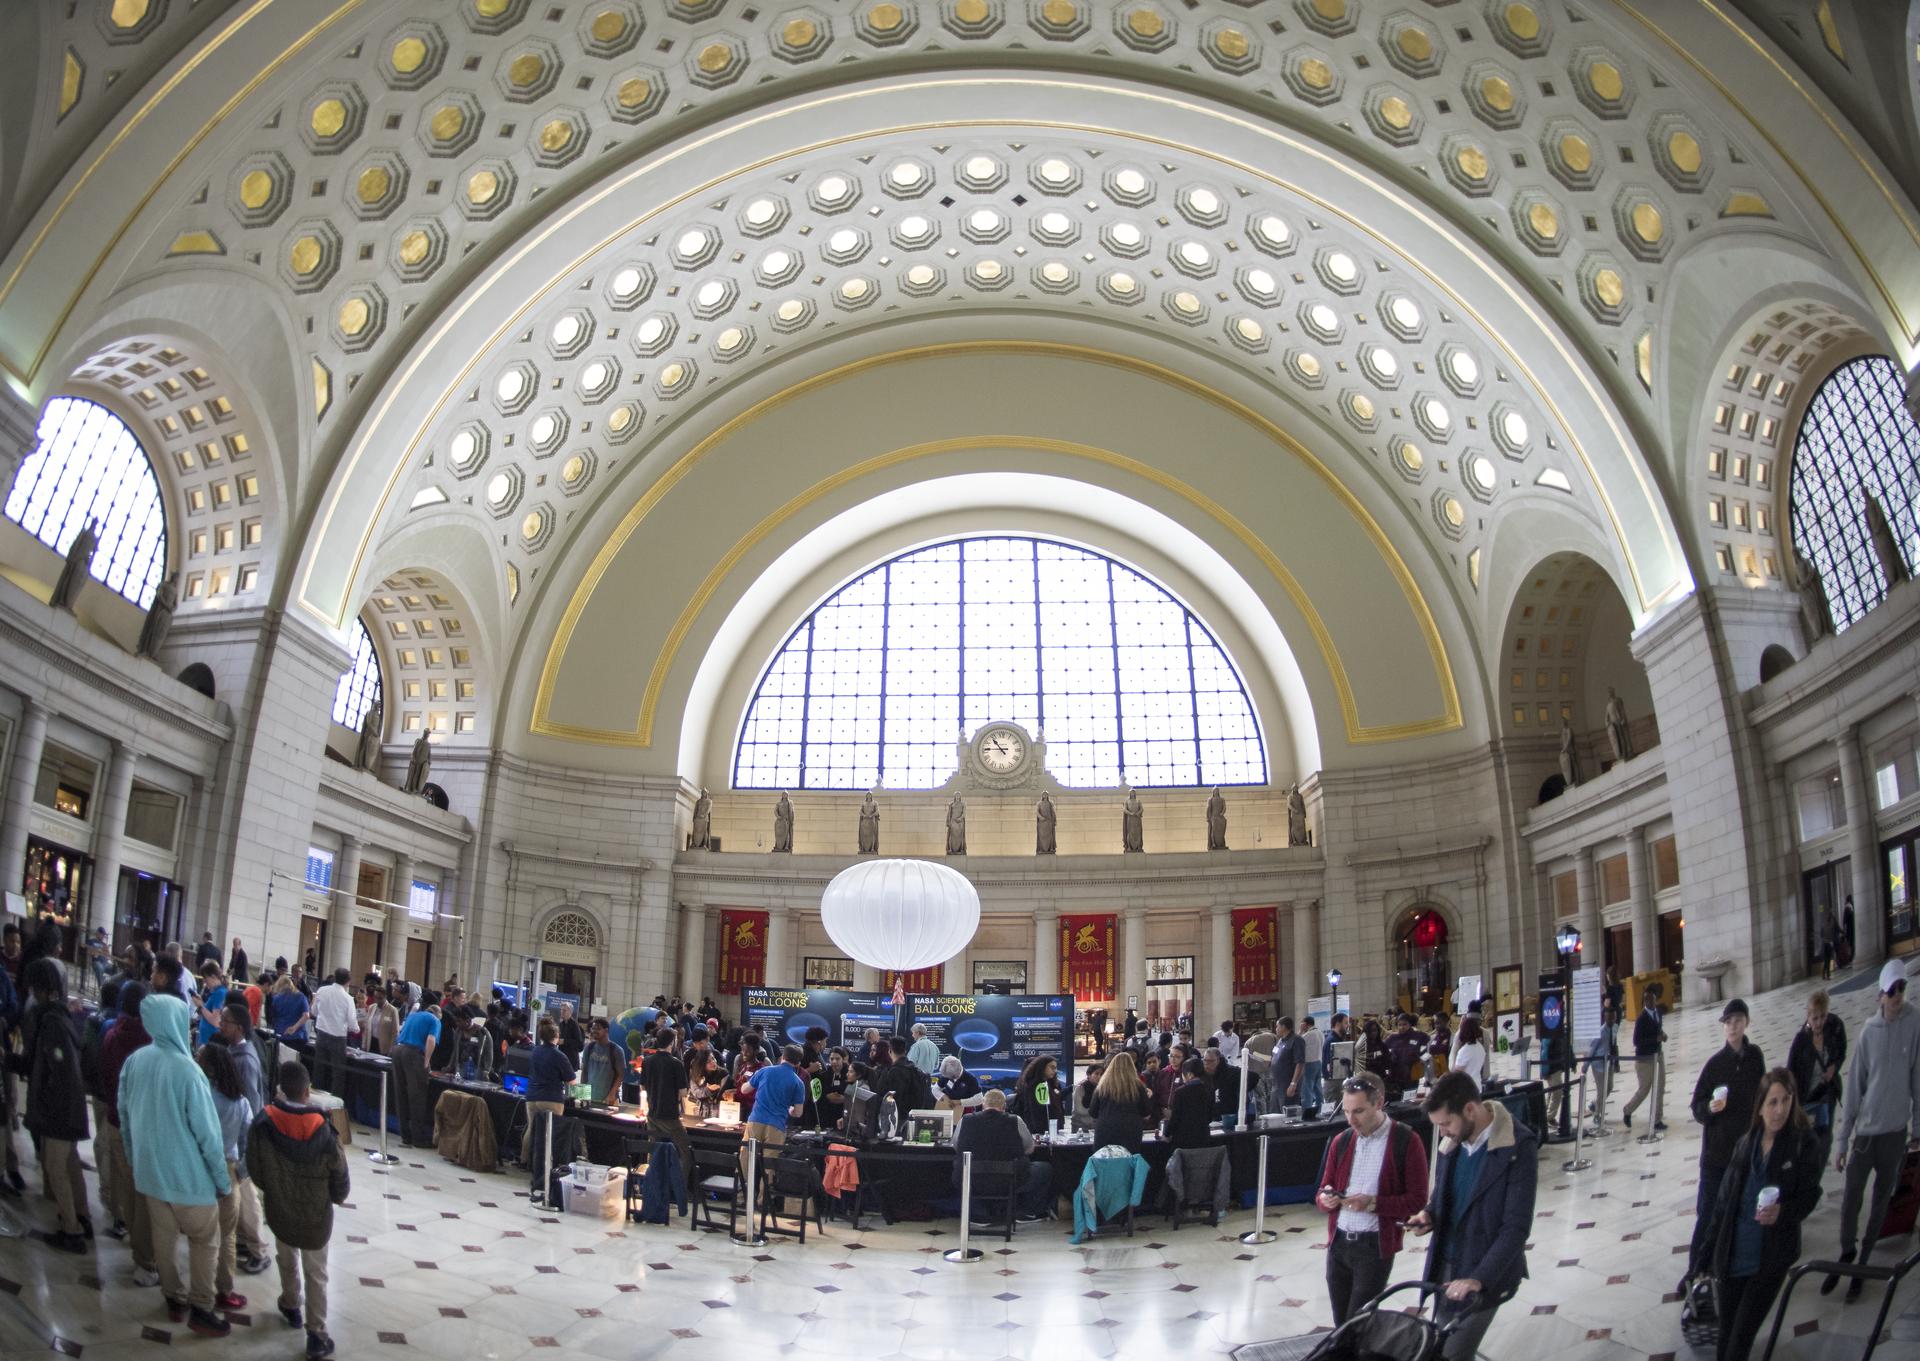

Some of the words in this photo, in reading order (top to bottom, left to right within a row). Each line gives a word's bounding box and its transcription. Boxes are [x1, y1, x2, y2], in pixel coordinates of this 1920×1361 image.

[1880, 810, 1920, 832] MASSACHUSETT
[769, 991, 807, 999] SCIENTIFIC
[748, 997, 807, 1008] BALLOONS
[914, 1004, 975, 1014] BALLOONS
[1543, 1009, 1561, 1017] NASA
[813, 1081, 821, 1096] 15
[1037, 1087, 1047, 1101] 17
